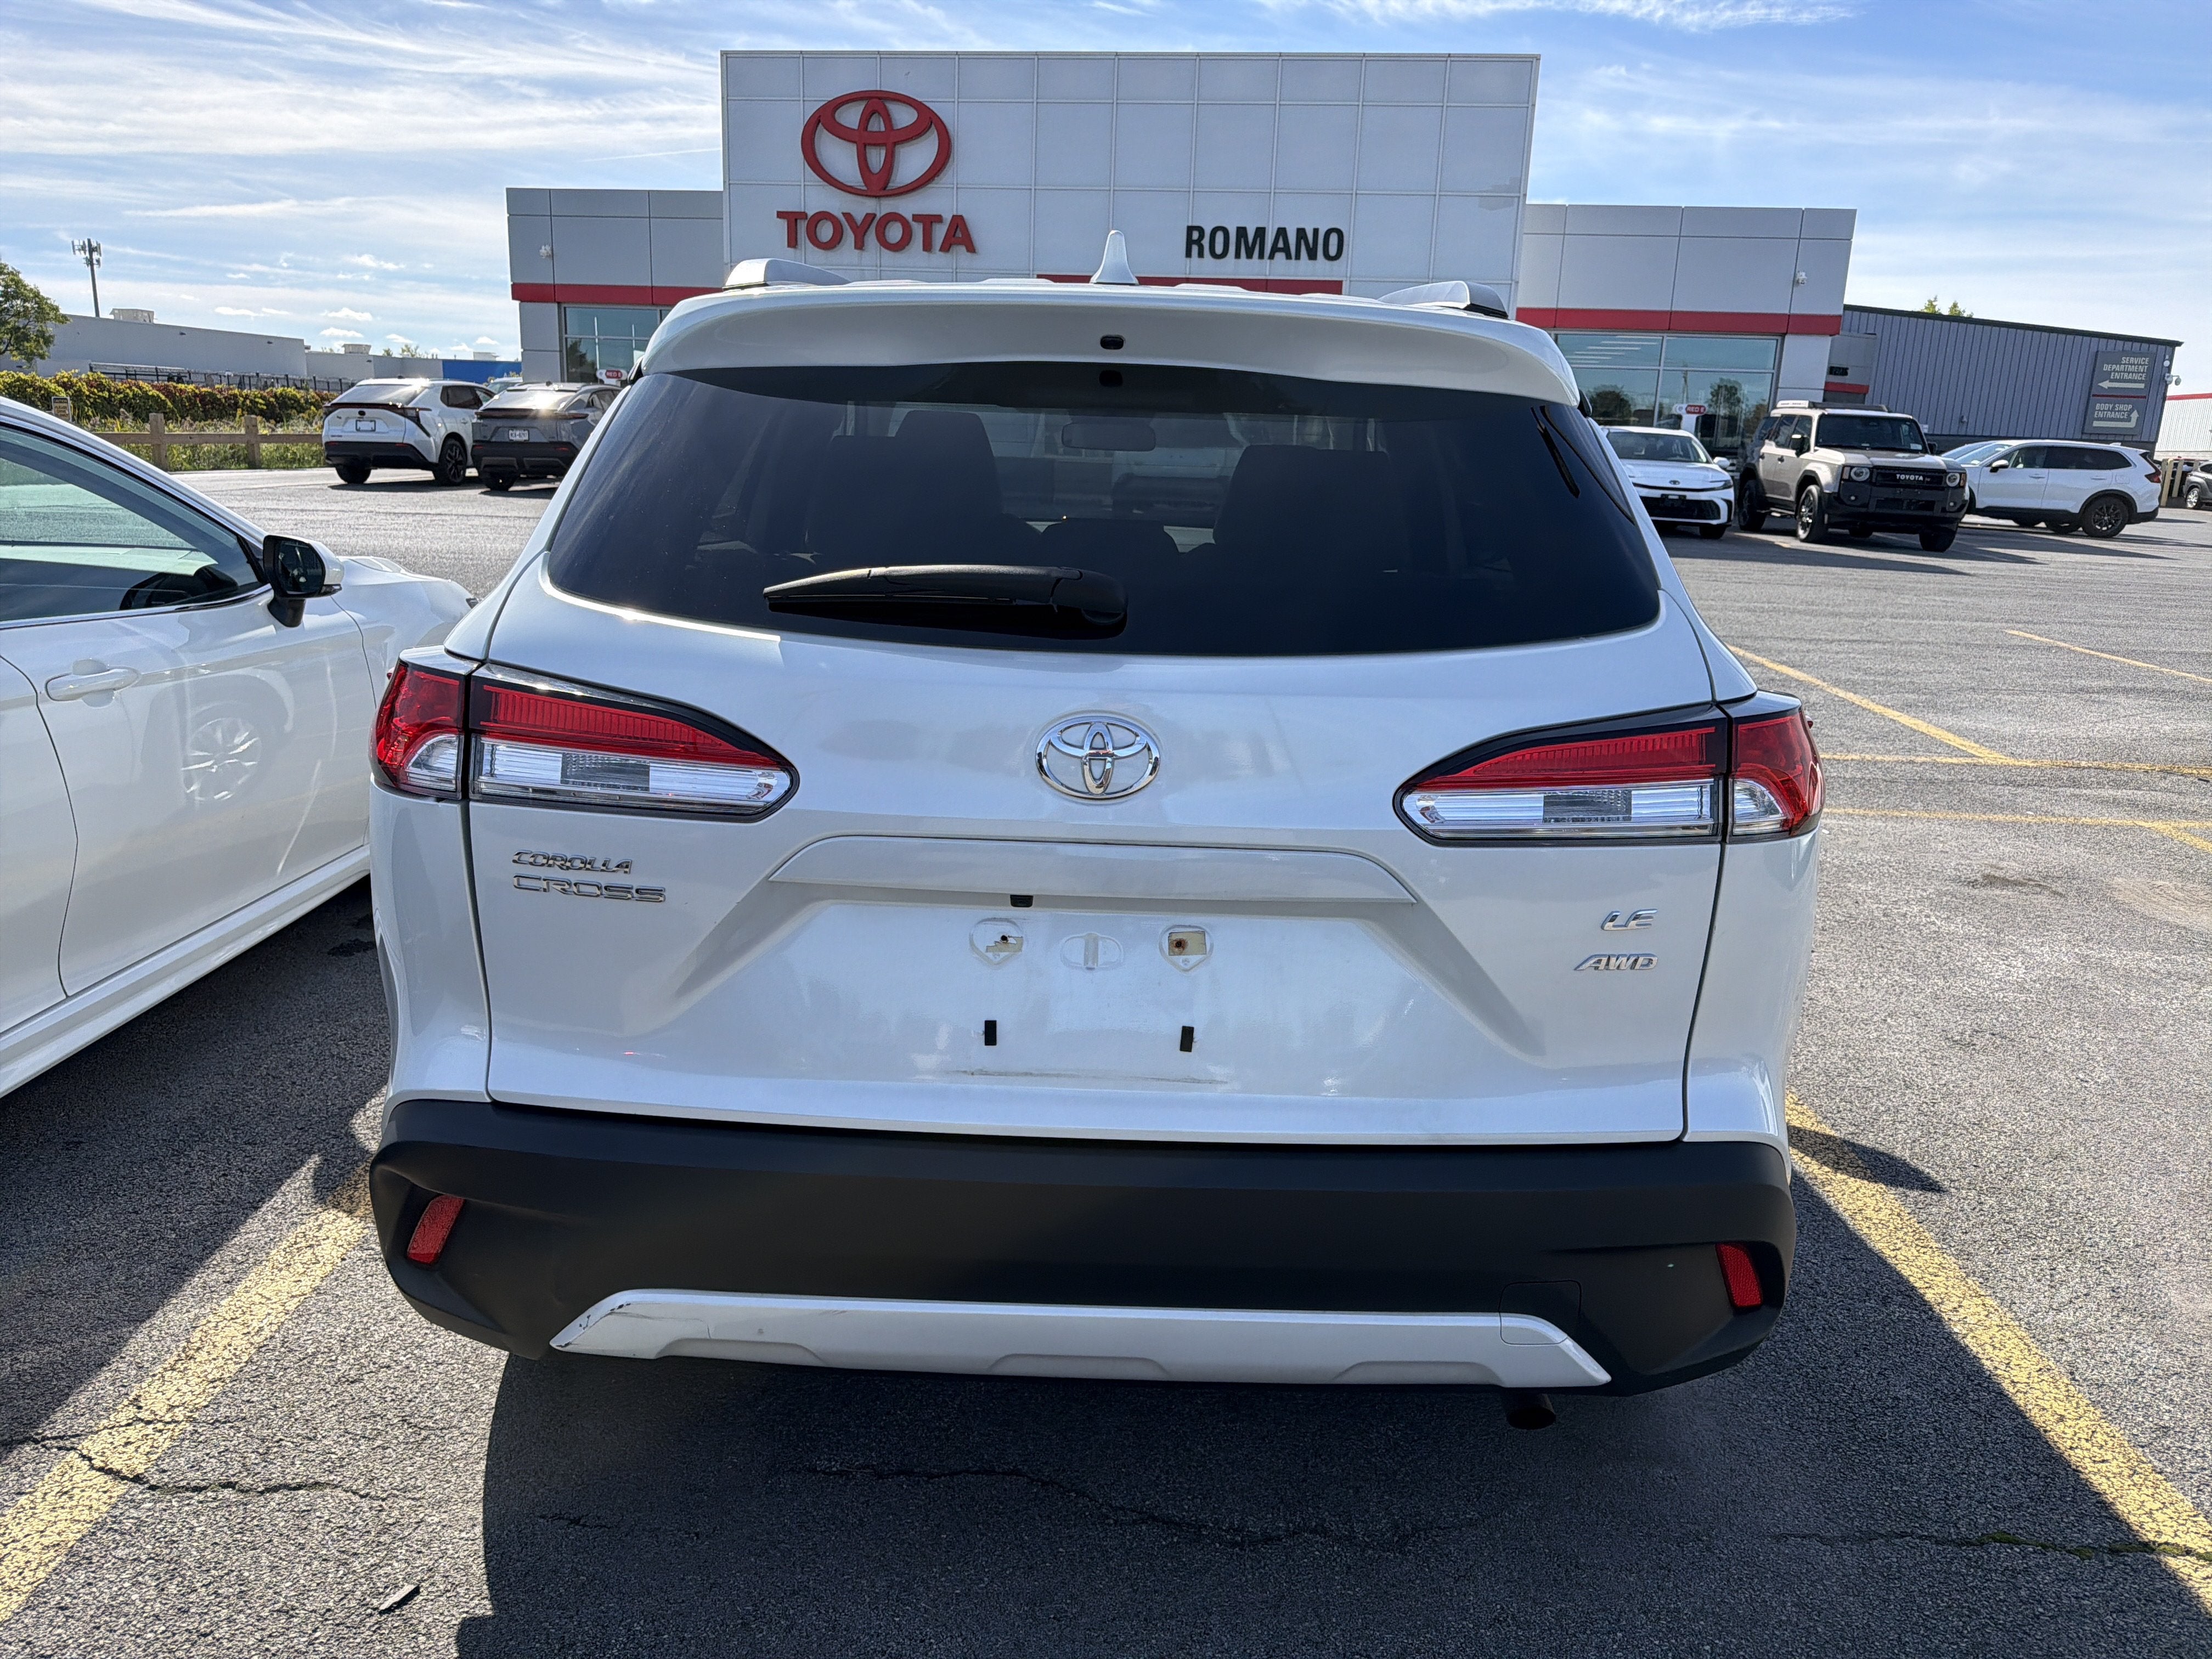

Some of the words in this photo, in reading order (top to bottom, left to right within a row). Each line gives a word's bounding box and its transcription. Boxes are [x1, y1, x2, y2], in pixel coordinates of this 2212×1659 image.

[776, 211, 977, 253] TOYOTA
[1185, 225, 1344, 261] ROMANO
[2103, 364, 2148, 373] DEPARTMENT
[512, 850, 633, 874] COROLLA
[513, 873, 666, 902] CROSS
[1600, 909, 1658, 931] LE
[1573, 953, 1658, 970] AWD
